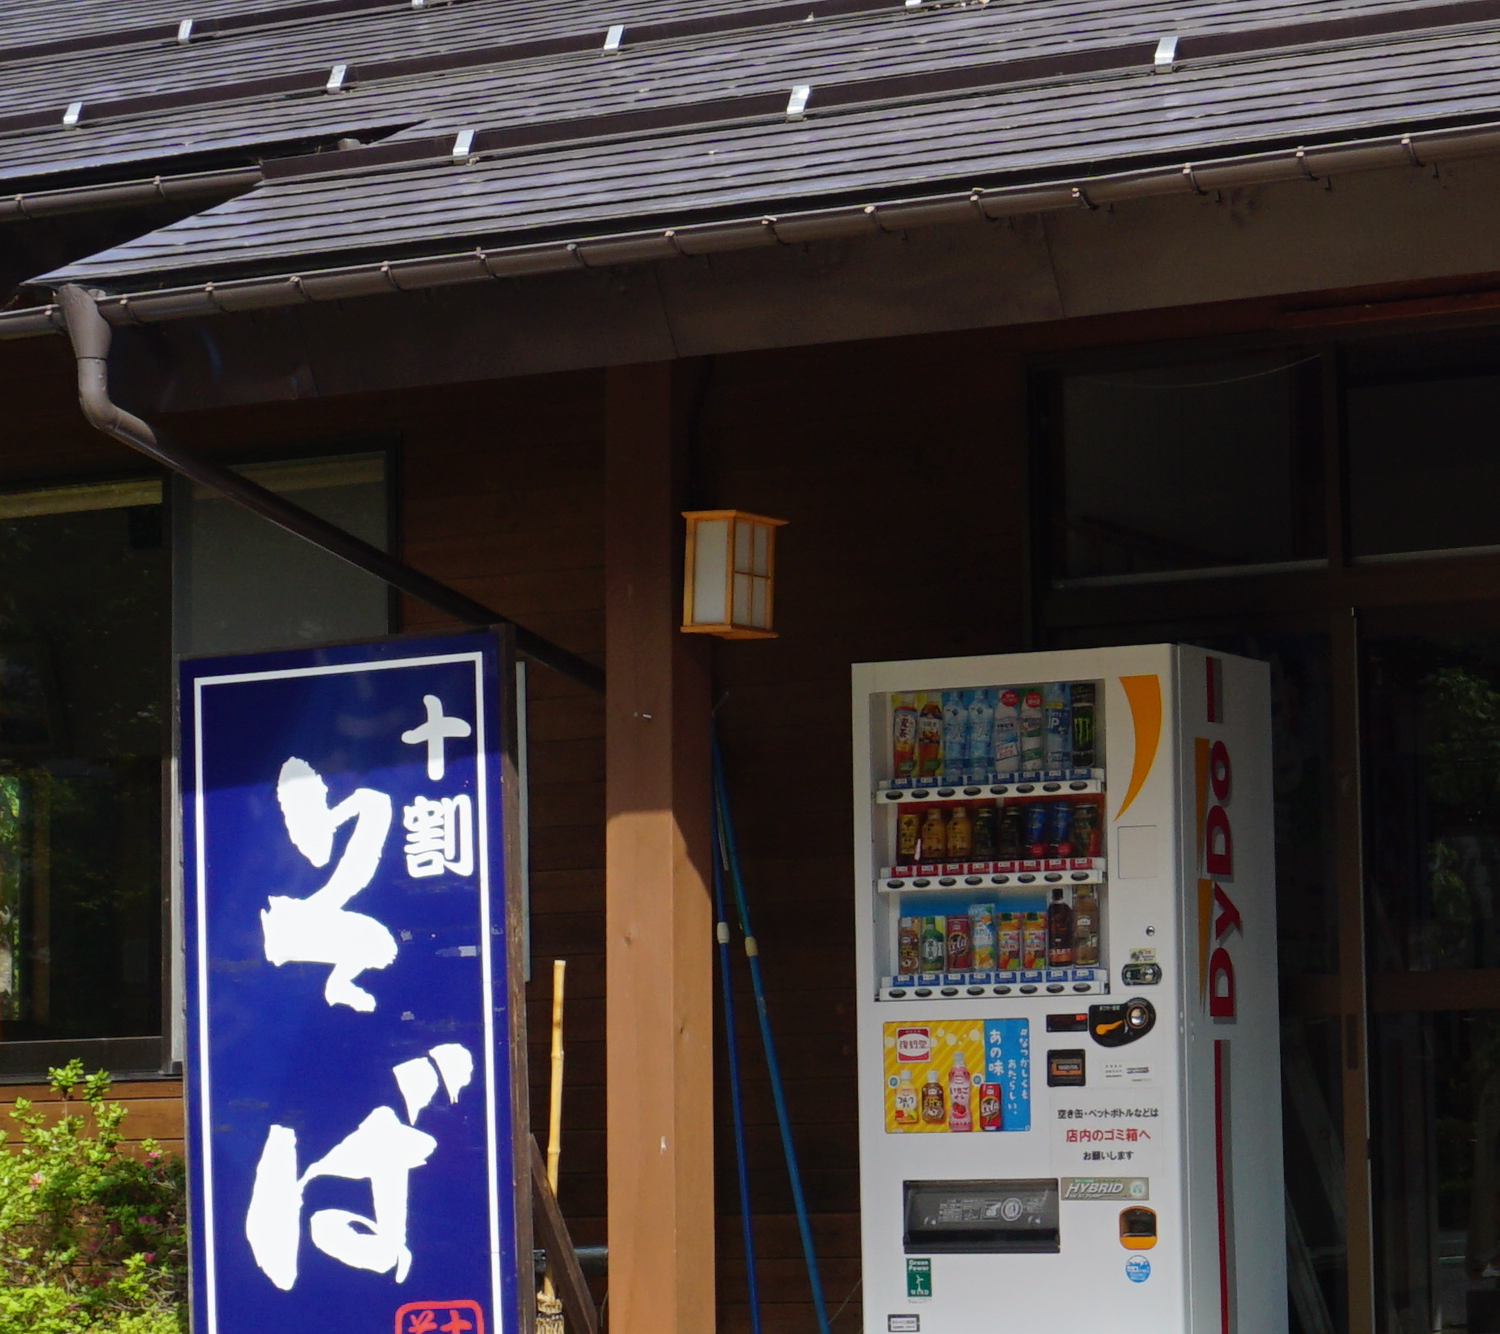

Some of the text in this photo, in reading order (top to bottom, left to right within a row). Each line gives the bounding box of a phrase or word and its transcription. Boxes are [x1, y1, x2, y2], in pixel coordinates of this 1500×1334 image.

[401, 694, 474, 879] 十割
[245, 755, 474, 1292] そば
[988, 1029, 1004, 1076] あの味
[1057, 1107, 1159, 1120] 空き缶・ペットボトルなどは
[1065, 1128, 1151, 1143] 店内のゴミ箱へ
[1083, 1150, 1134, 1161] お願いします
[1065, 1182, 1124, 1198] HYBRID
